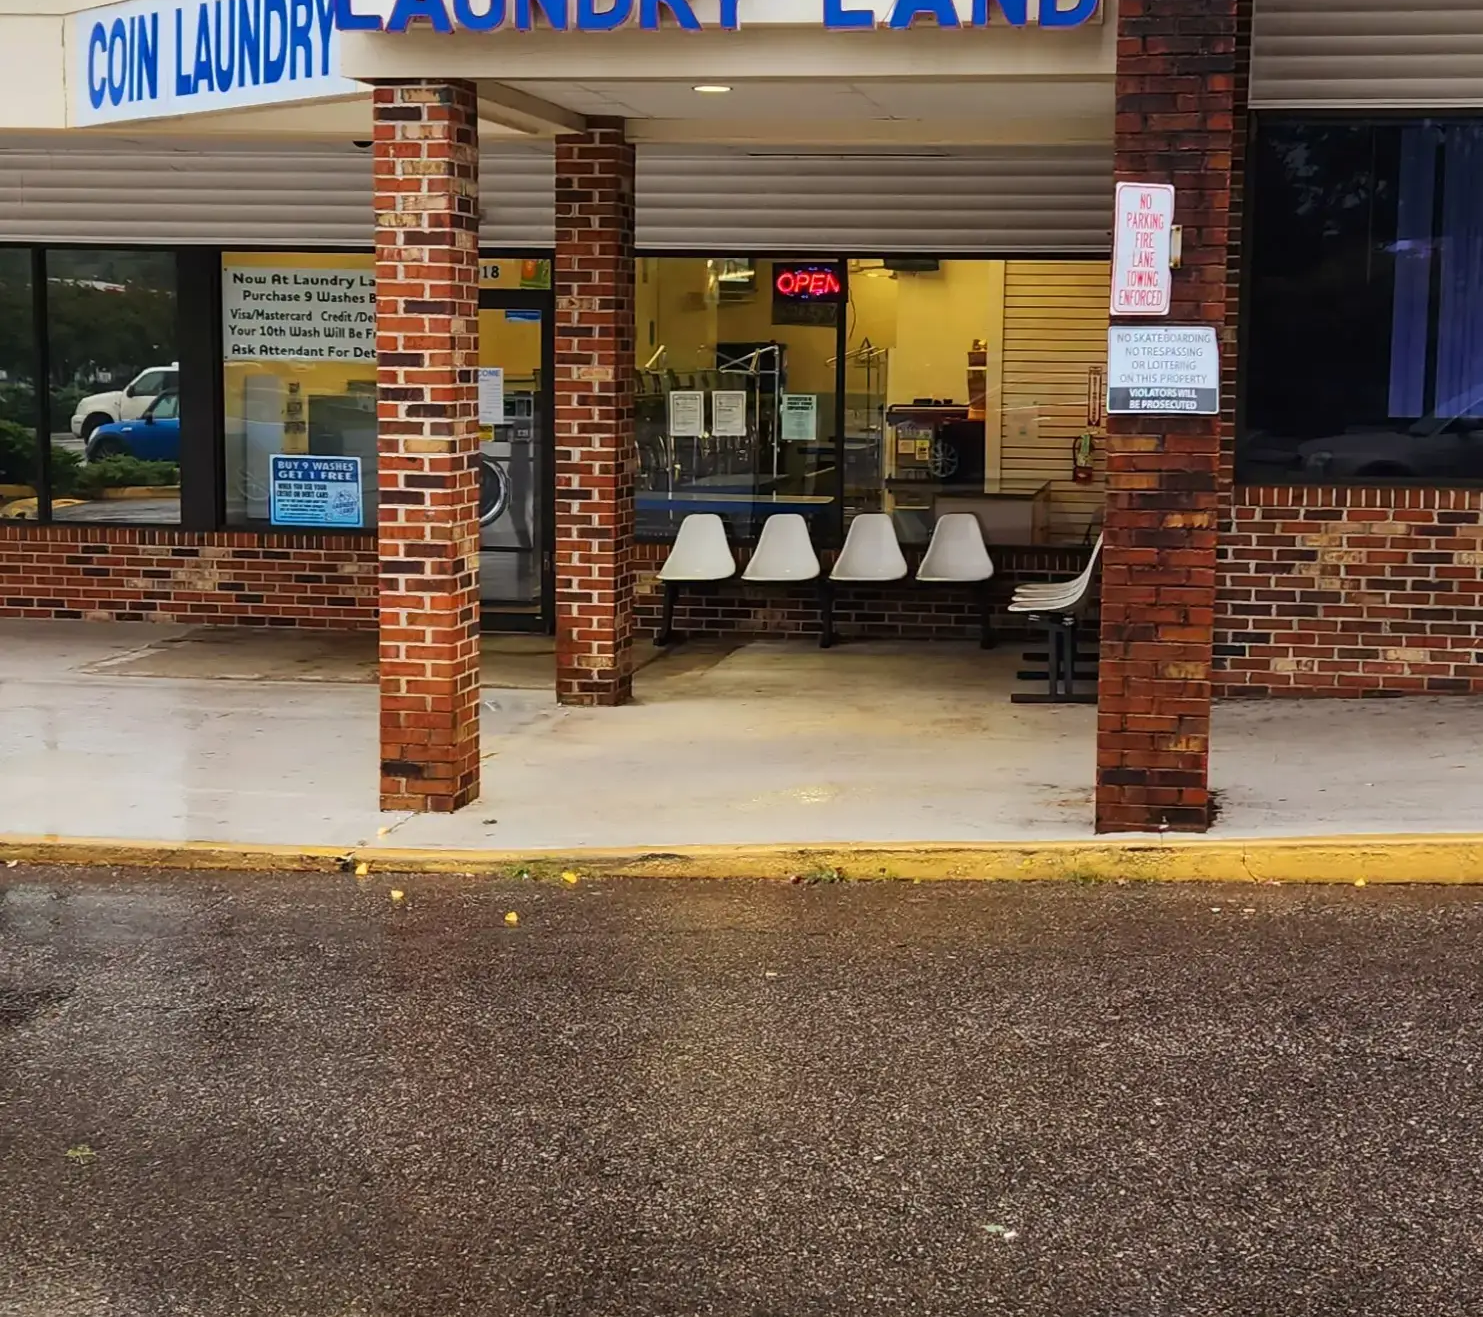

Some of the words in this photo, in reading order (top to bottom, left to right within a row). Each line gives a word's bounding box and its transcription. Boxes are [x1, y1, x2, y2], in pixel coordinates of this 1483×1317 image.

[88, 11, 159, 110] COIN
[1140, 193, 1152, 209] NO
[1127, 212, 1164, 230] PARKING
[1135, 232, 1155, 249] FIRE
[1132, 251, 1156, 268] LANE
[478, 265, 500, 279] 18
[1126, 270, 1159, 288] TOWING
[232, 273, 267, 285] Now
[271, 274, 289, 285] At
[293, 275, 355, 289] Laundry
[359, 276, 376, 287] La
[777, 272, 840, 294] OPEN
[242, 290, 300, 302] Purchase
[304, 291, 313, 302] 9
[317, 291, 365, 303] Washes
[369, 293, 377, 303] B
[1119, 289, 1162, 306] ENFORCED
[230, 308, 312, 321] Visa/Mastercard
[320, 311, 352, 322] Credit
[228, 325, 257, 336] Your
[259, 326, 286, 337] 10th
[289, 327, 320, 338] Wash
[323, 327, 345, 338] Will
[348, 328, 363, 339] Be
[1117, 334, 1131, 343] NO
[1134, 334, 1211, 343] SKATEBOARDING
[231, 344, 256, 355] Ask
[259, 344, 324, 357] Attendant
[327, 346, 350, 357] For
[1125, 347, 1140, 356] NO
[1142, 347, 1203, 357] TRESPASSING
[1131, 360, 1145, 370] OR
[1147, 361, 1197, 370] LOITERING
[1119, 374, 1134, 383] ON
[1137, 374, 1158, 383] THIS
[1160, 374, 1207, 384] PROPERTY
[1129, 388, 1177, 397] VIOLATORS
[1177, 389, 1198, 398] WILL
[1129, 400, 1141, 409] BE
[1141, 400, 1197, 409] PROSECUTED
[277, 461, 300, 470] BUY
[301, 461, 309, 470] 9
[312, 462, 354, 471] WASHES
[278, 470, 304, 479] GET
[308, 471, 316, 479] 1
[320, 471, 353, 480] FREE
